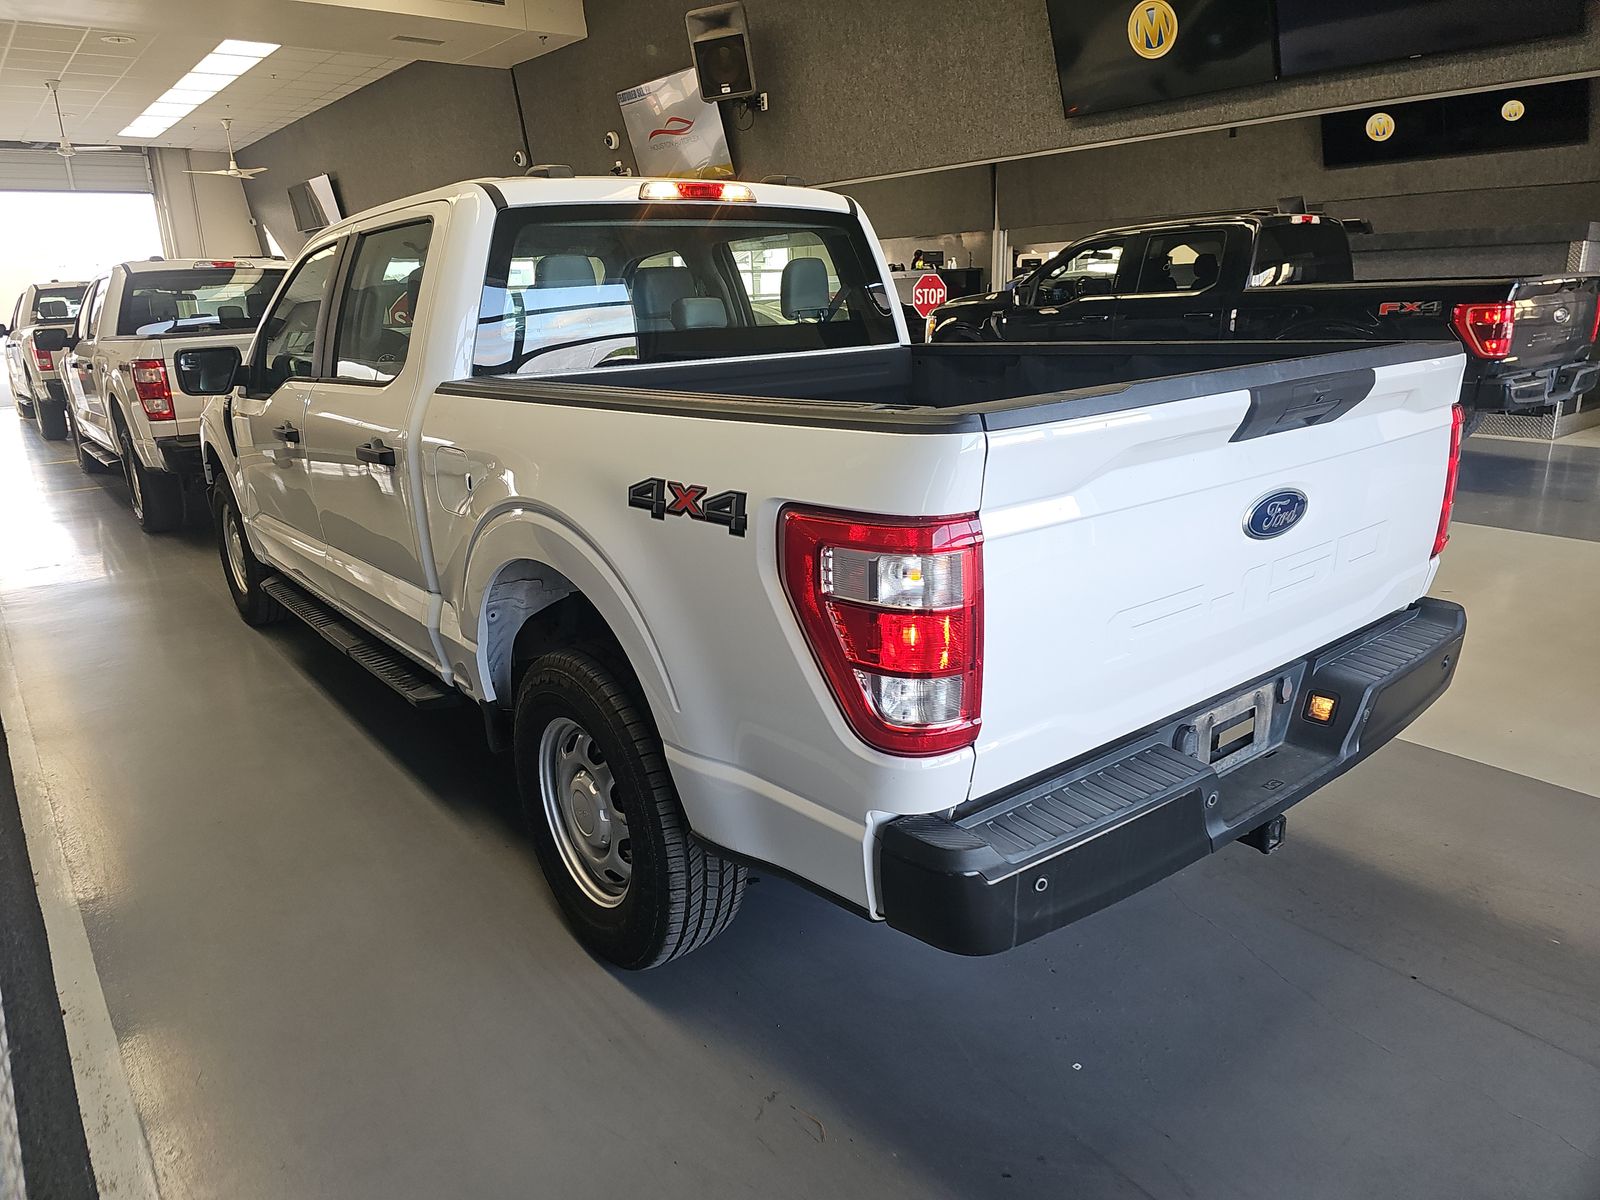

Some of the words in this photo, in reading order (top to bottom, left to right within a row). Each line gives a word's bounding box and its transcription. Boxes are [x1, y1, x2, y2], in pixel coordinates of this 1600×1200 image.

[915, 288, 944, 305] STOP
[1379, 301, 1442, 315] FX4
[1262, 498, 1299, 530] Ford
